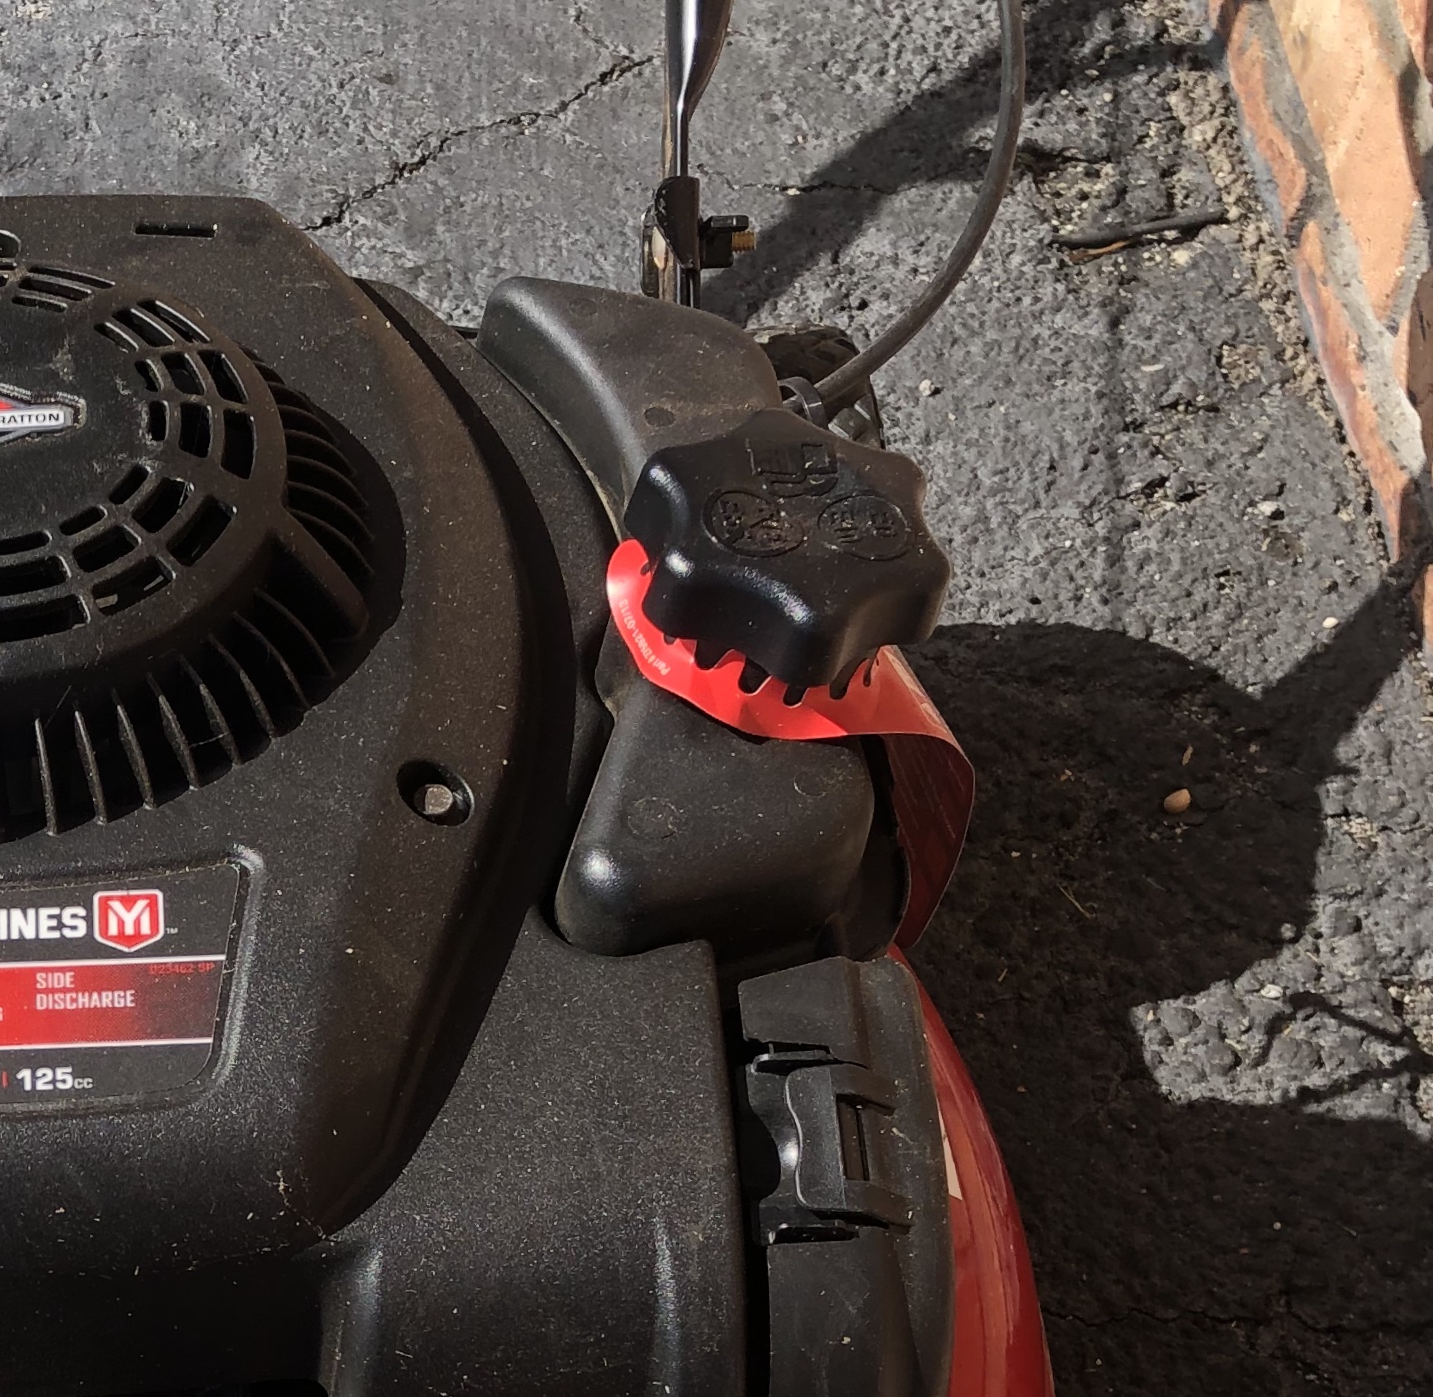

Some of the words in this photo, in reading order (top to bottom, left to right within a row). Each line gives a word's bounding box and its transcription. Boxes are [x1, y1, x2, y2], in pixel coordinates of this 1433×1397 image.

[36, 971, 75, 989] SIDE
[36, 990, 135, 1010] DISCHARGE
[16, 1066, 93, 1091] 125cc
